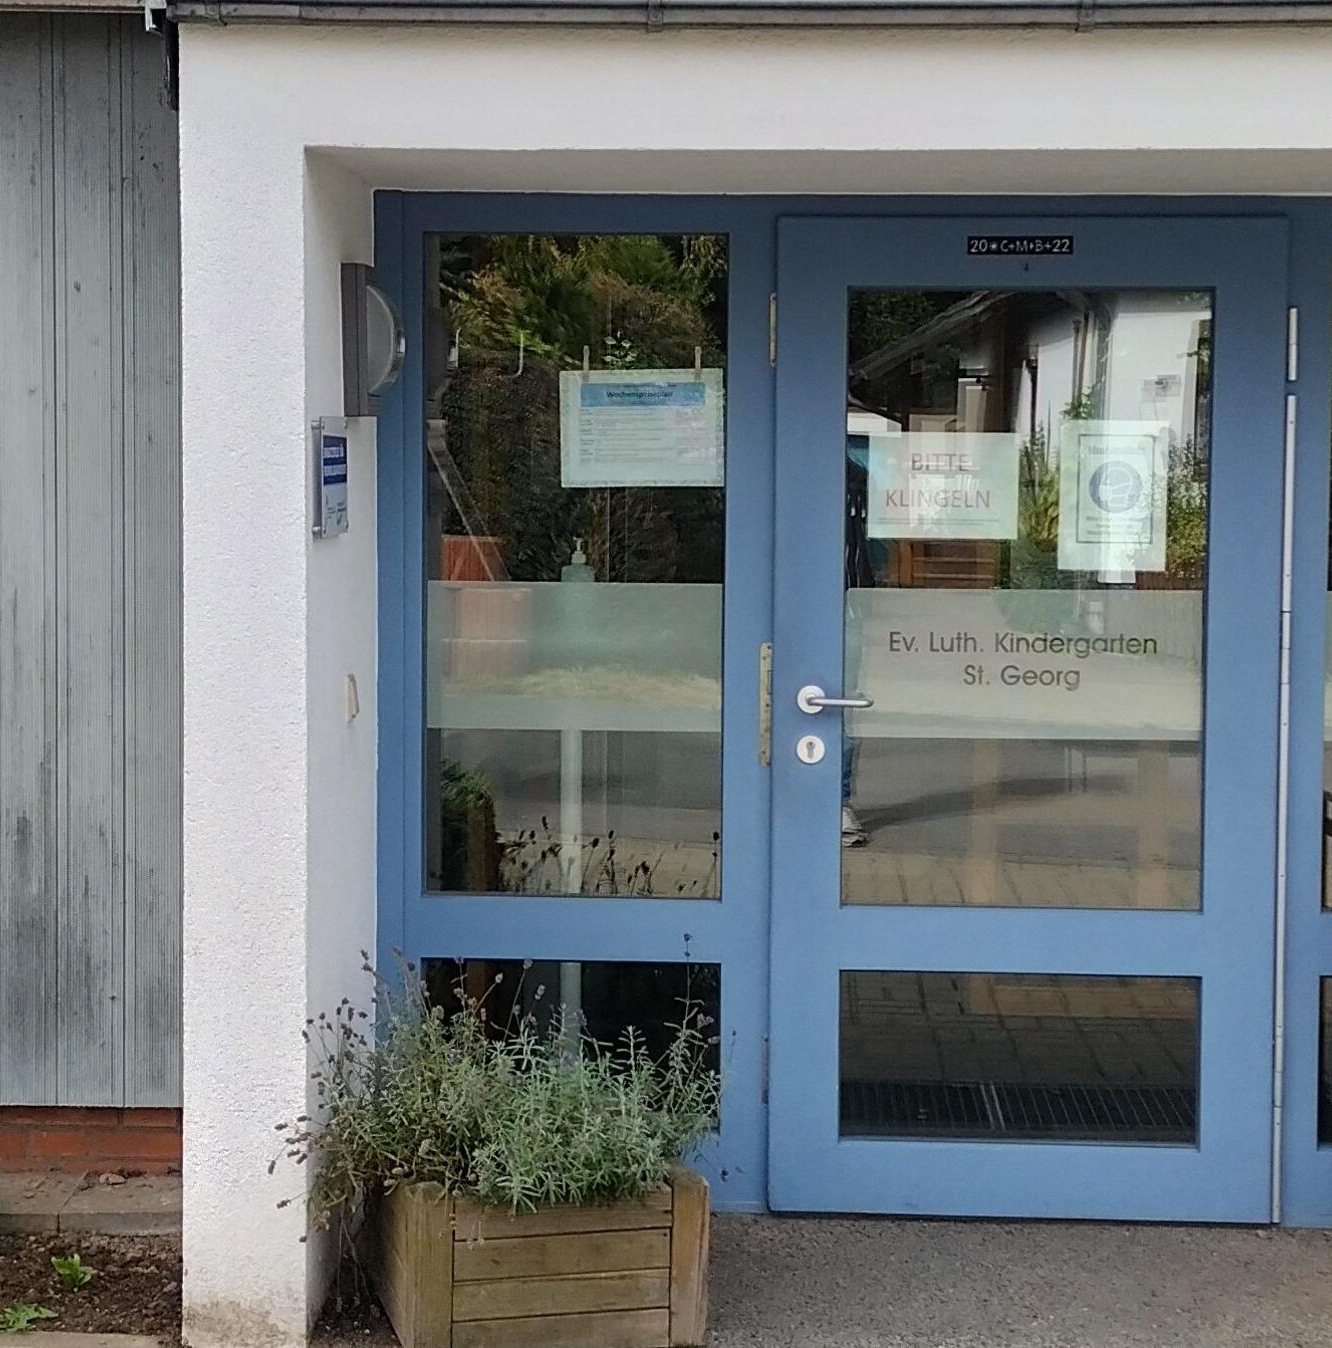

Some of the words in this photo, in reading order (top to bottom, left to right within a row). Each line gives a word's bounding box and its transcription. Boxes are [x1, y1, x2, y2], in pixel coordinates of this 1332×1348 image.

[911, 453, 969, 471] BITTE
[886, 489, 991, 509] KLINGELN
[888, 631, 919, 652] Ev.
[929, 631, 984, 653] Luth.
[995, 632, 1158, 659] Kindergarten
[963, 664, 990, 686] St.
[1001, 664, 1081, 691] Georg
